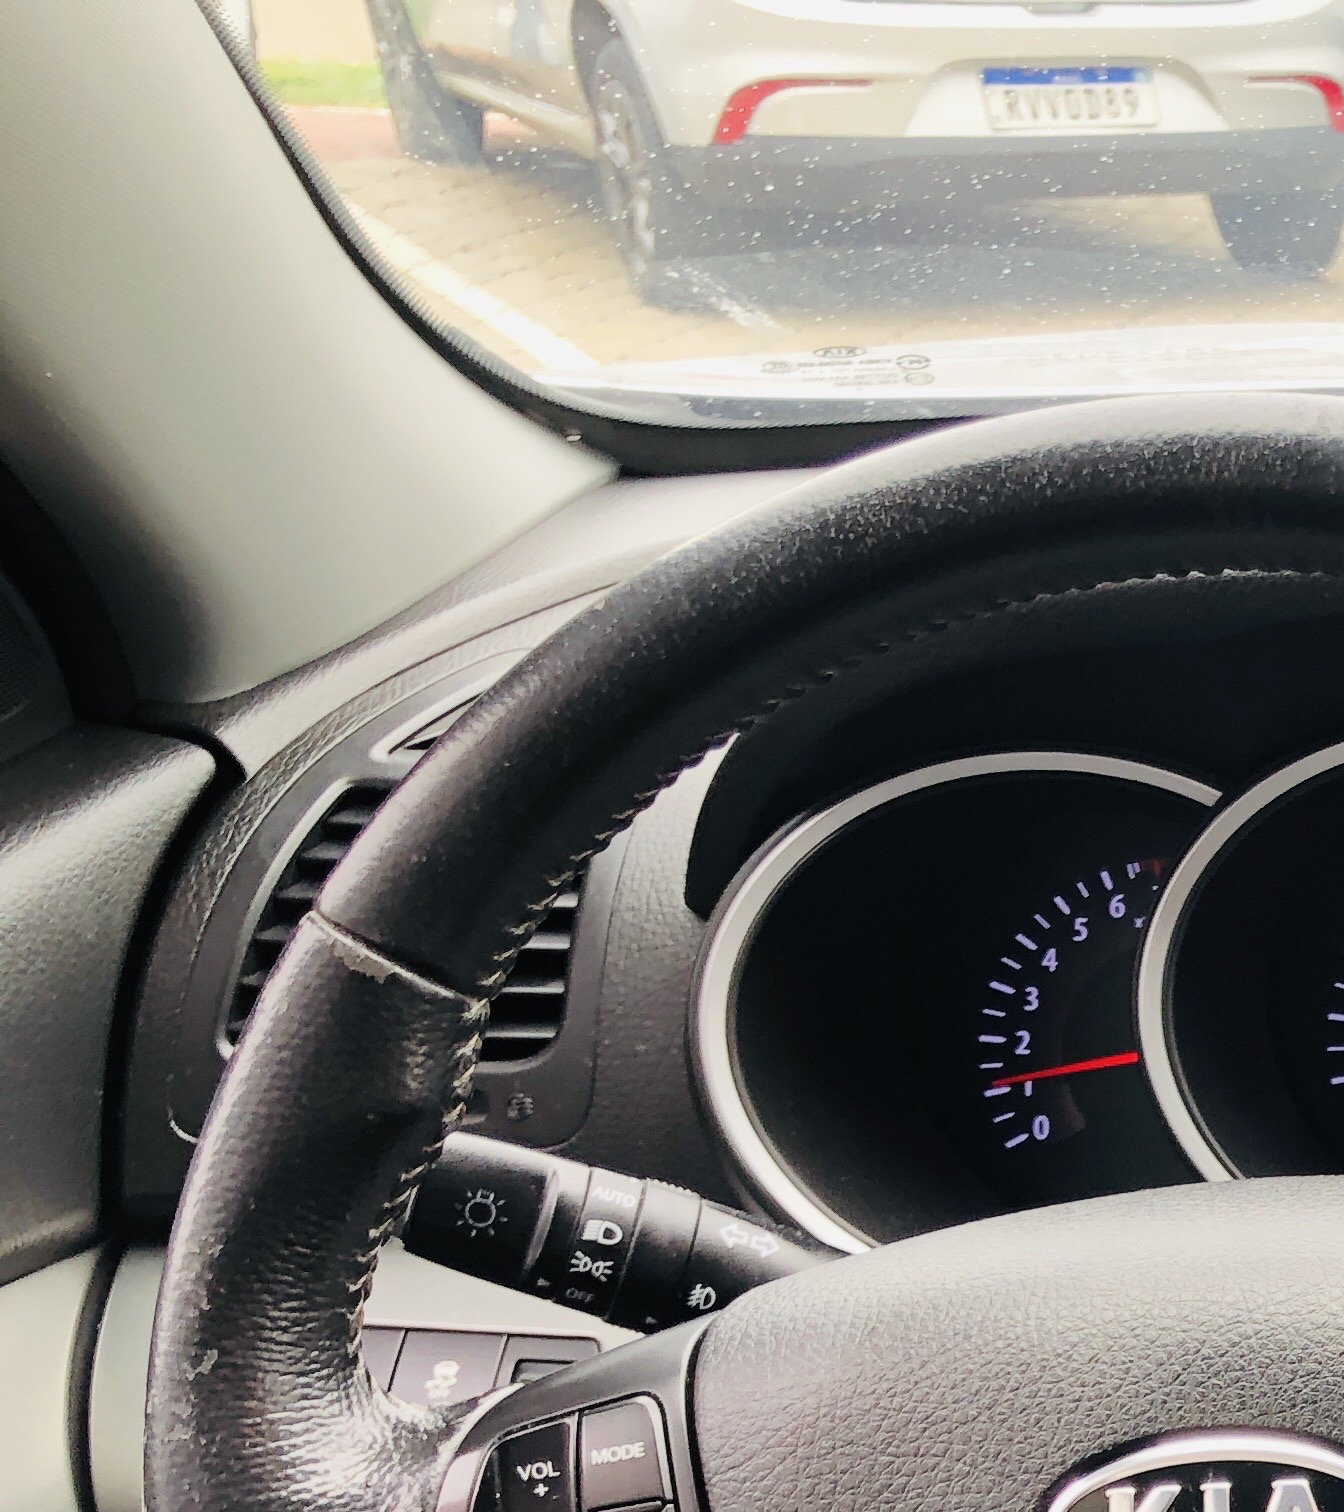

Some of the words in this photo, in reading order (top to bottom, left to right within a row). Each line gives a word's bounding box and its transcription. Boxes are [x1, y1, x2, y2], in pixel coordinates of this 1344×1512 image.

[1109, 893, 1126, 919] 6
[1072, 917, 1089, 942] 5
[1041, 948, 1058, 972] 4
[1023, 987, 1039, 1011] 3
[1014, 1030, 1031, 1055] 2
[1032, 1115, 1050, 1140] 0
[592, 1186, 636, 1207] AUTO
[590, 1441, 646, 1466] MODE
[516, 1460, 561, 1482] VOL
